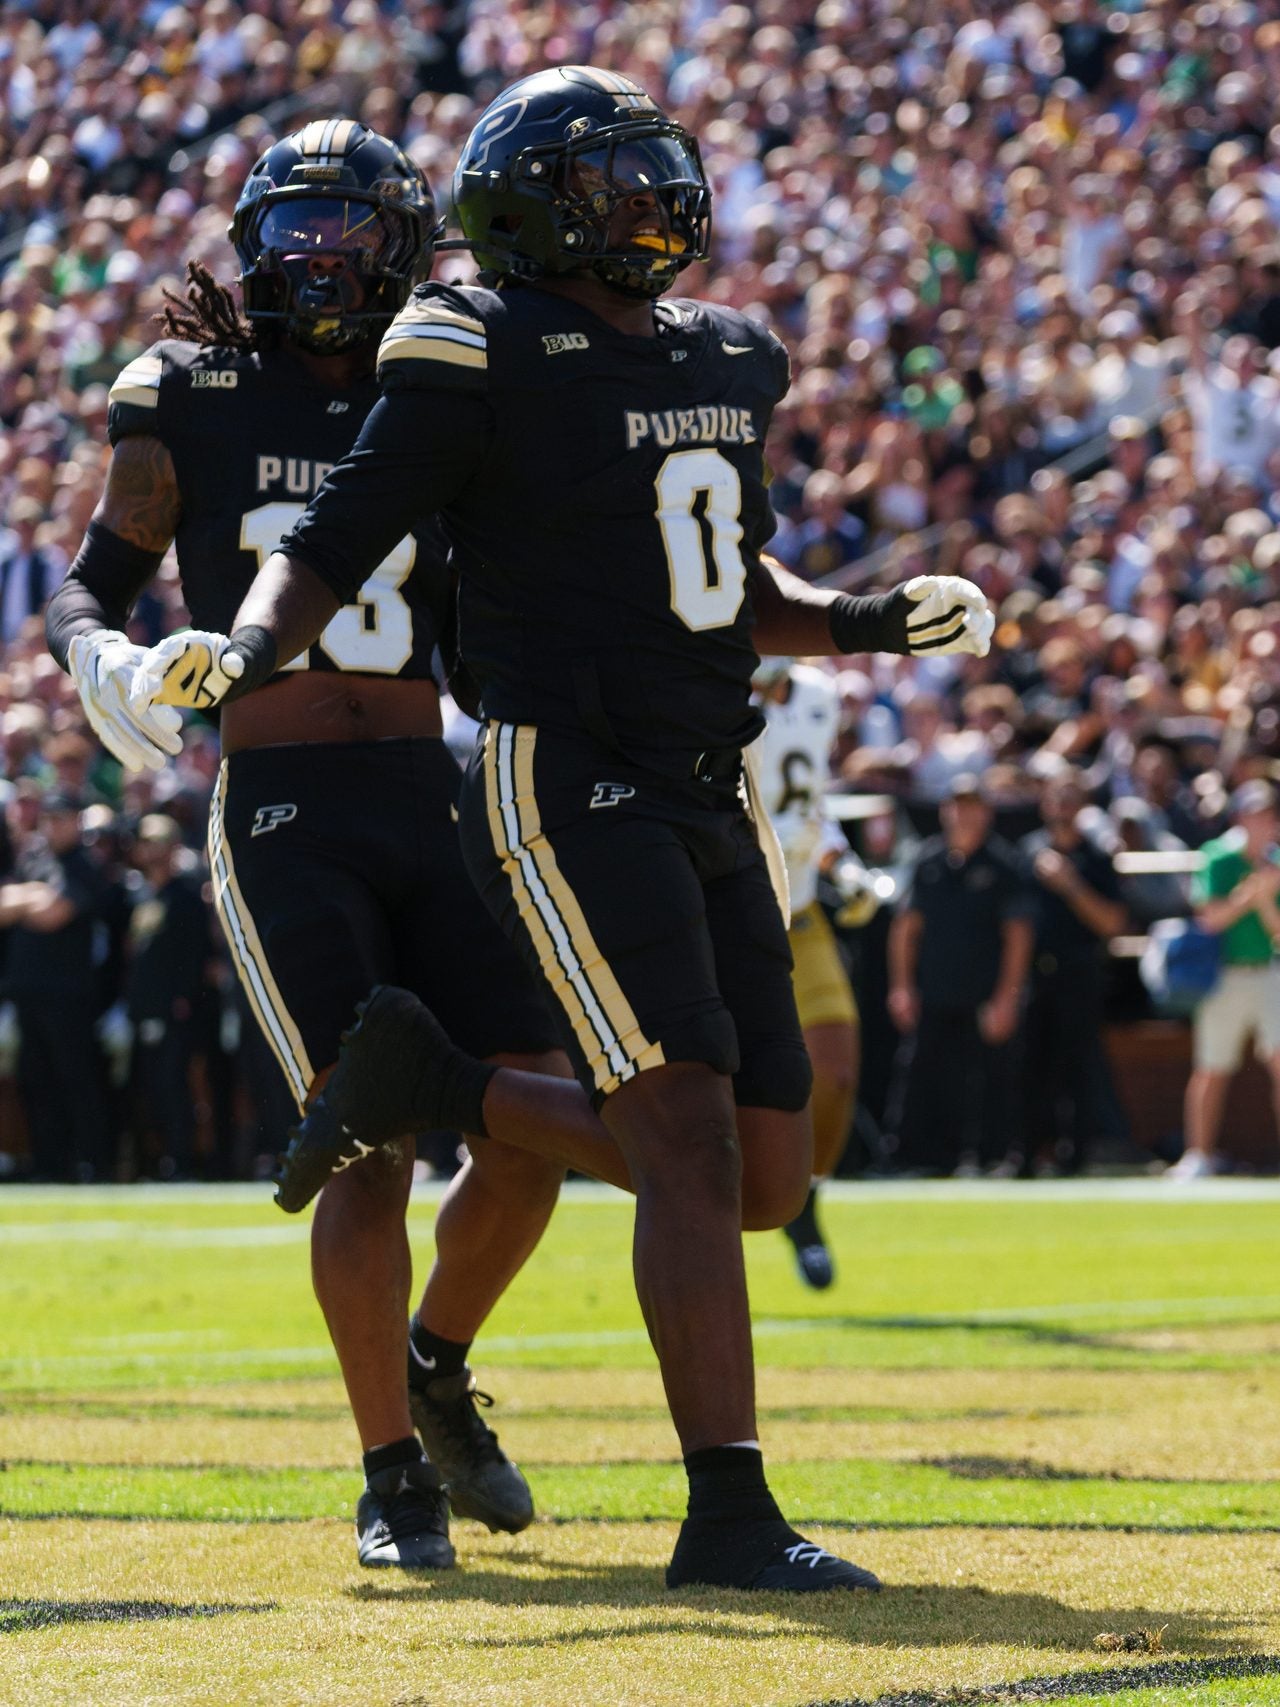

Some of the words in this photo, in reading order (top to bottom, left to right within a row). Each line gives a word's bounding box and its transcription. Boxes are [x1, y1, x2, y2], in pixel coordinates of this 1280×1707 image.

[625, 405, 758, 450] PURDUE
[653, 447, 748, 633] 0
[588, 782, 635, 809] P
[251, 803, 297, 838] P
